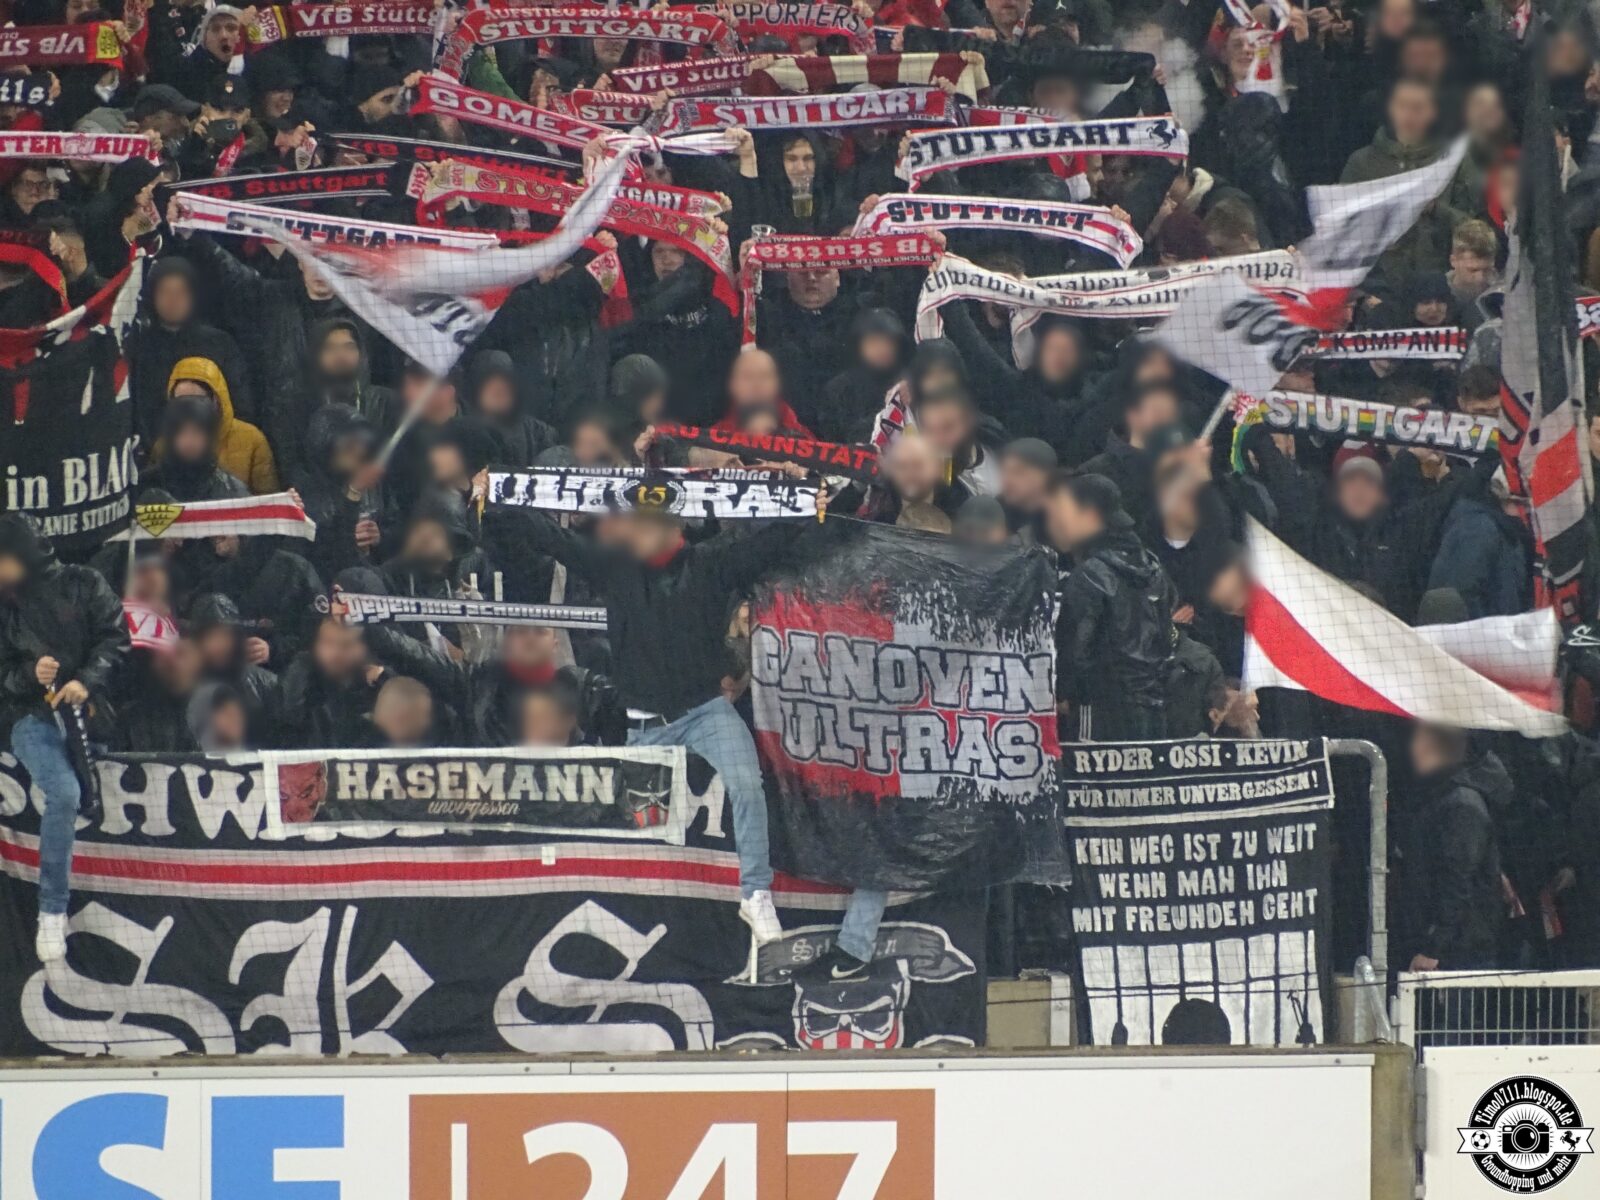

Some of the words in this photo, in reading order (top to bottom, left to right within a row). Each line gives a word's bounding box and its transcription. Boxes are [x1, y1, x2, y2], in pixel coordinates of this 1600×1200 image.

[298, 8, 353, 27] VfB
[480, 19, 708, 44] STUTTGART
[652, 10, 694, 22] LIGA
[697, 3, 861, 32] PPORTERS
[622, 71, 678, 92] VfB
[428, 87, 595, 143] GOMEZ
[713, 87, 929, 129] STUTTGART
[909, 123, 1136, 168] STUTTGART
[244, 172, 388, 198] Stuttgart
[887, 201, 1093, 230] STUTTGART
[1264, 390, 1501, 452] STUTTGART
[5, 464, 49, 511] in
[751, 625, 1056, 714] GANOVEN
[780, 699, 1044, 780] ULTRAS
[1074, 747, 1154, 773] RYDER
[1169, 744, 1222, 769] OSSI
[1235, 741, 1309, 767] KEVIN
[335, 761, 616, 804] HASEMANN
[1067, 785, 1105, 808] FÜR
[1107, 785, 1176, 808] IMMER
[427, 799, 520, 818] unvergessen
[1075, 837, 1124, 866] KEIN
[1130, 833, 1175, 865] WEG
[1183, 832, 1221, 863] IST
[1231, 830, 1258, 859] ZU
[1266, 823, 1318, 854] WEIT
[1099, 871, 1167, 899] WENN
[1178, 865, 1235, 897] MAN
[1246, 859, 1288, 891] IHN
[1072, 906, 1117, 933] MIT
[1125, 900, 1255, 933] FREUNDEN
[1262, 888, 1318, 920] GEHT
